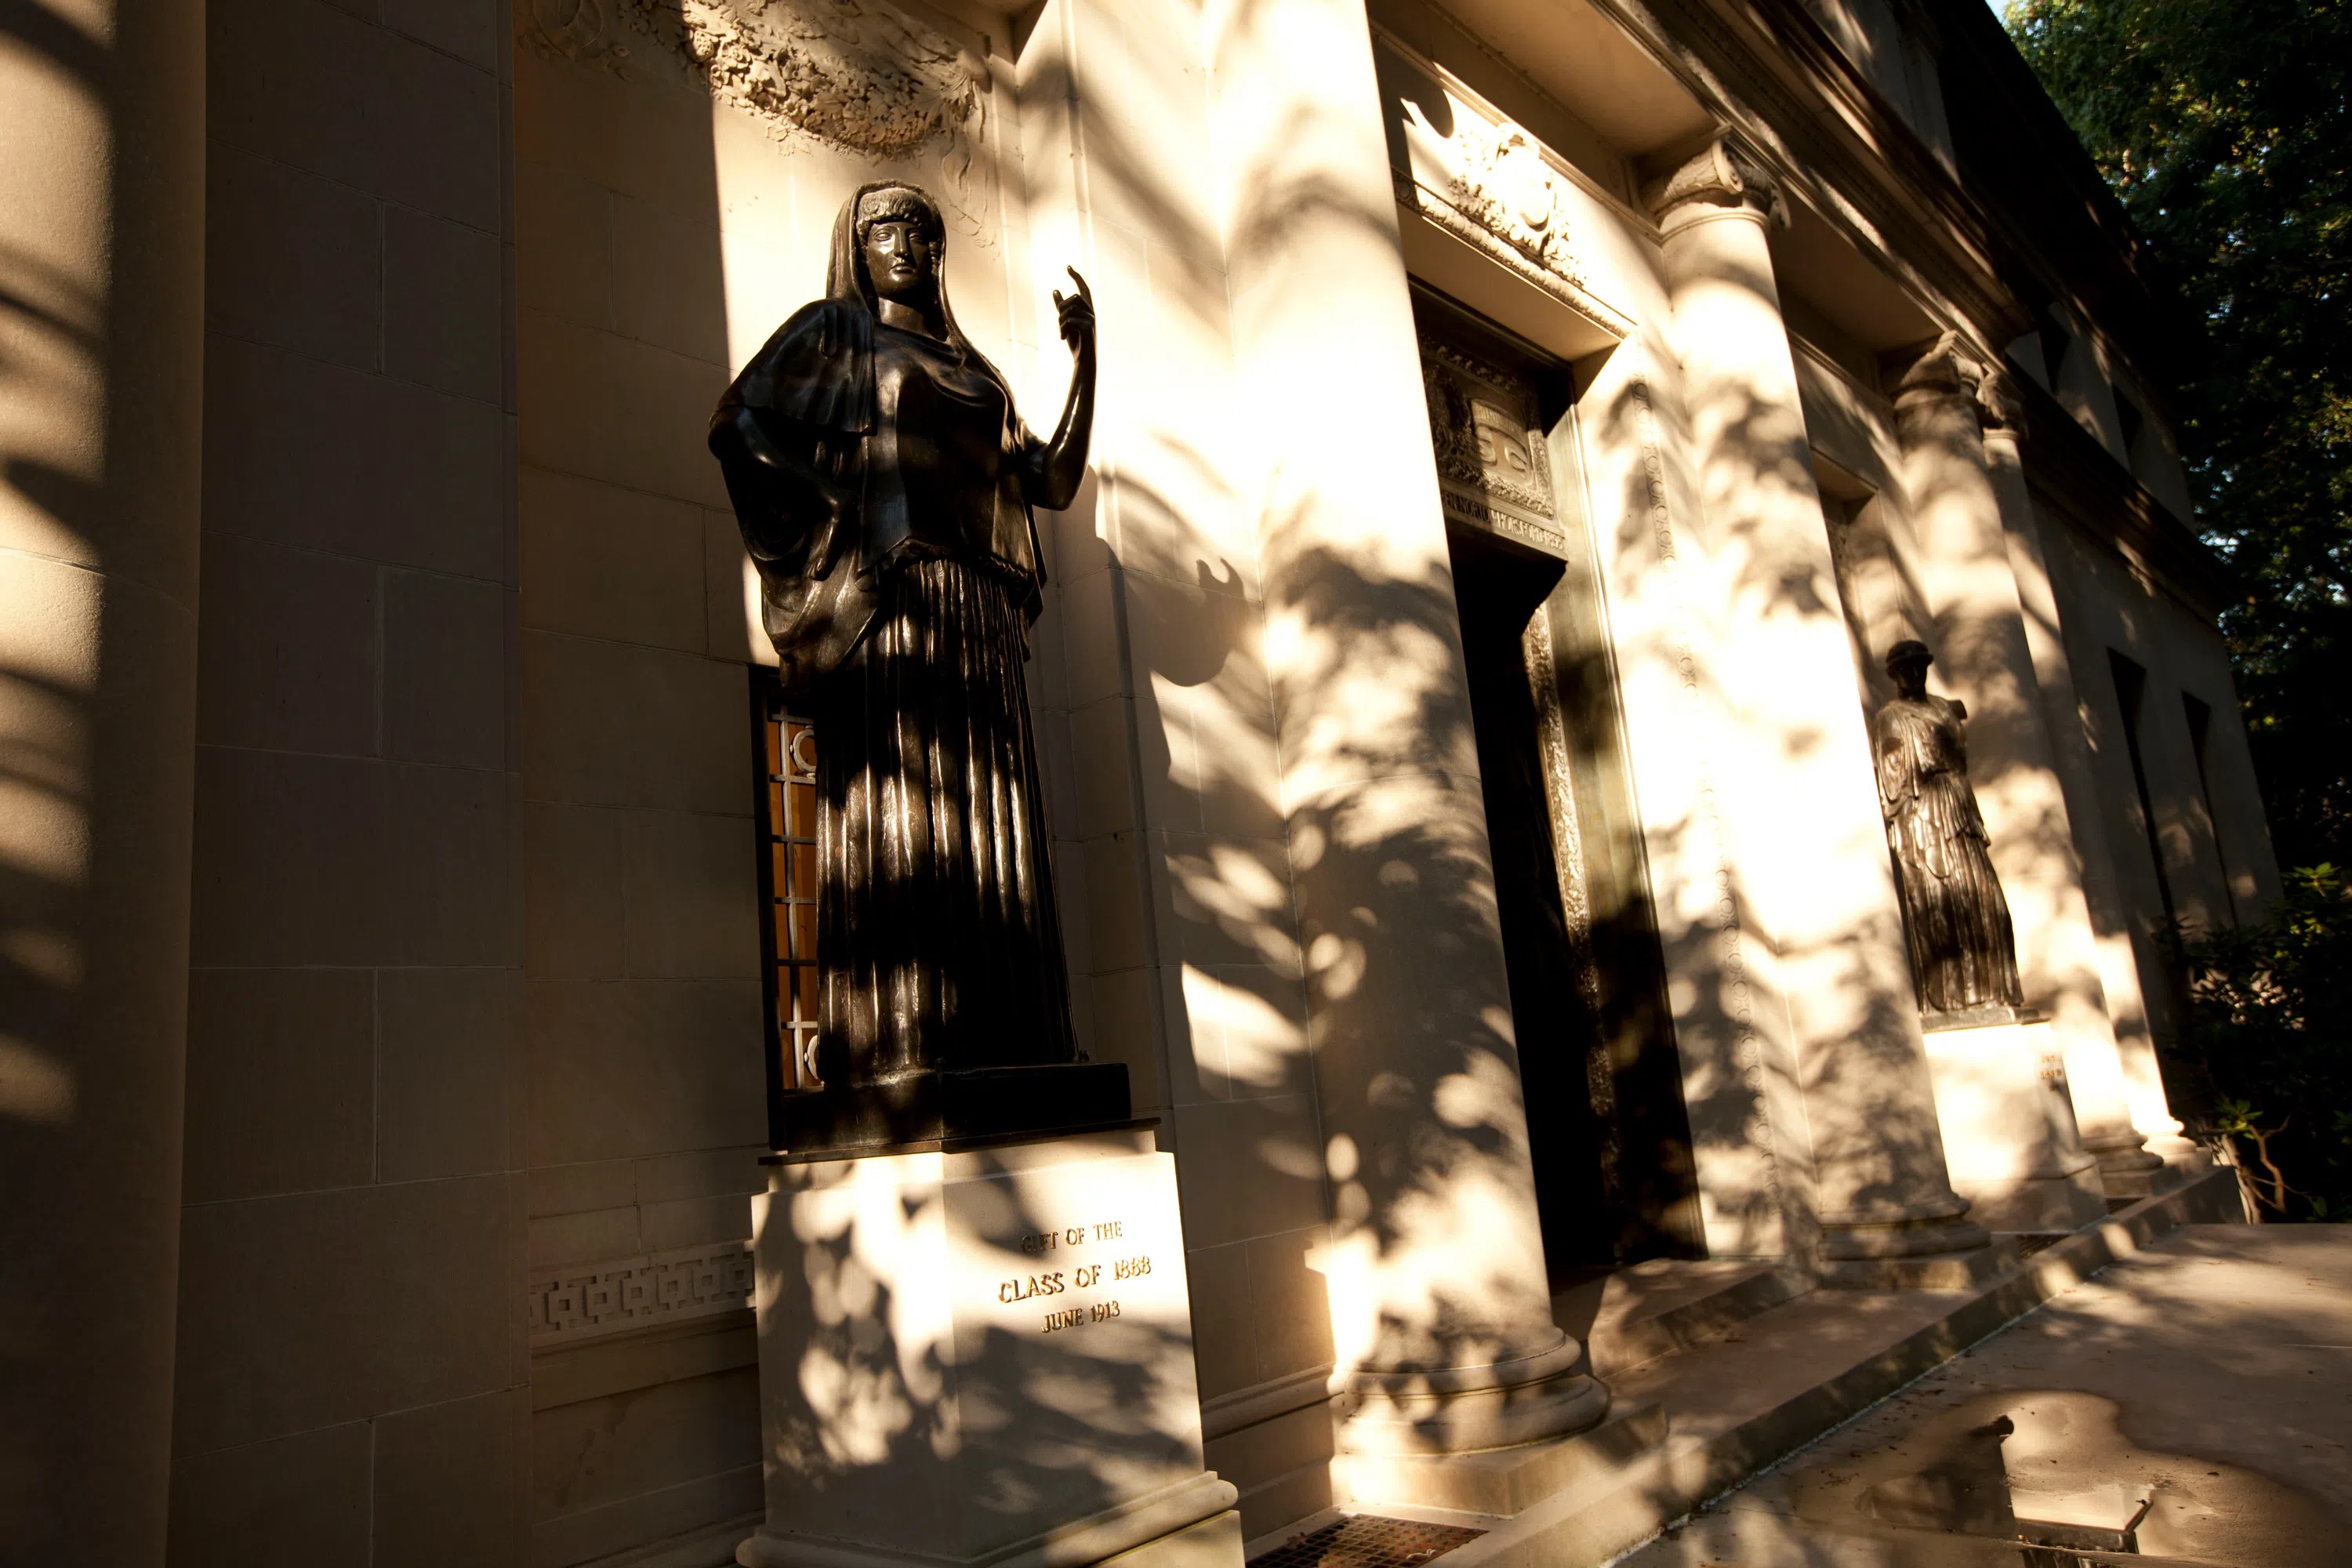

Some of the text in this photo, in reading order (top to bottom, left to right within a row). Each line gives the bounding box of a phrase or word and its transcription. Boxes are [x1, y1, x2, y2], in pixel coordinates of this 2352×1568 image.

[1021, 1221, 1122, 1253] GIFT OF THE
[998, 1255, 1152, 1303] CLASS OF 1888
[1040, 1300, 1120, 1333] JUNE 1913
